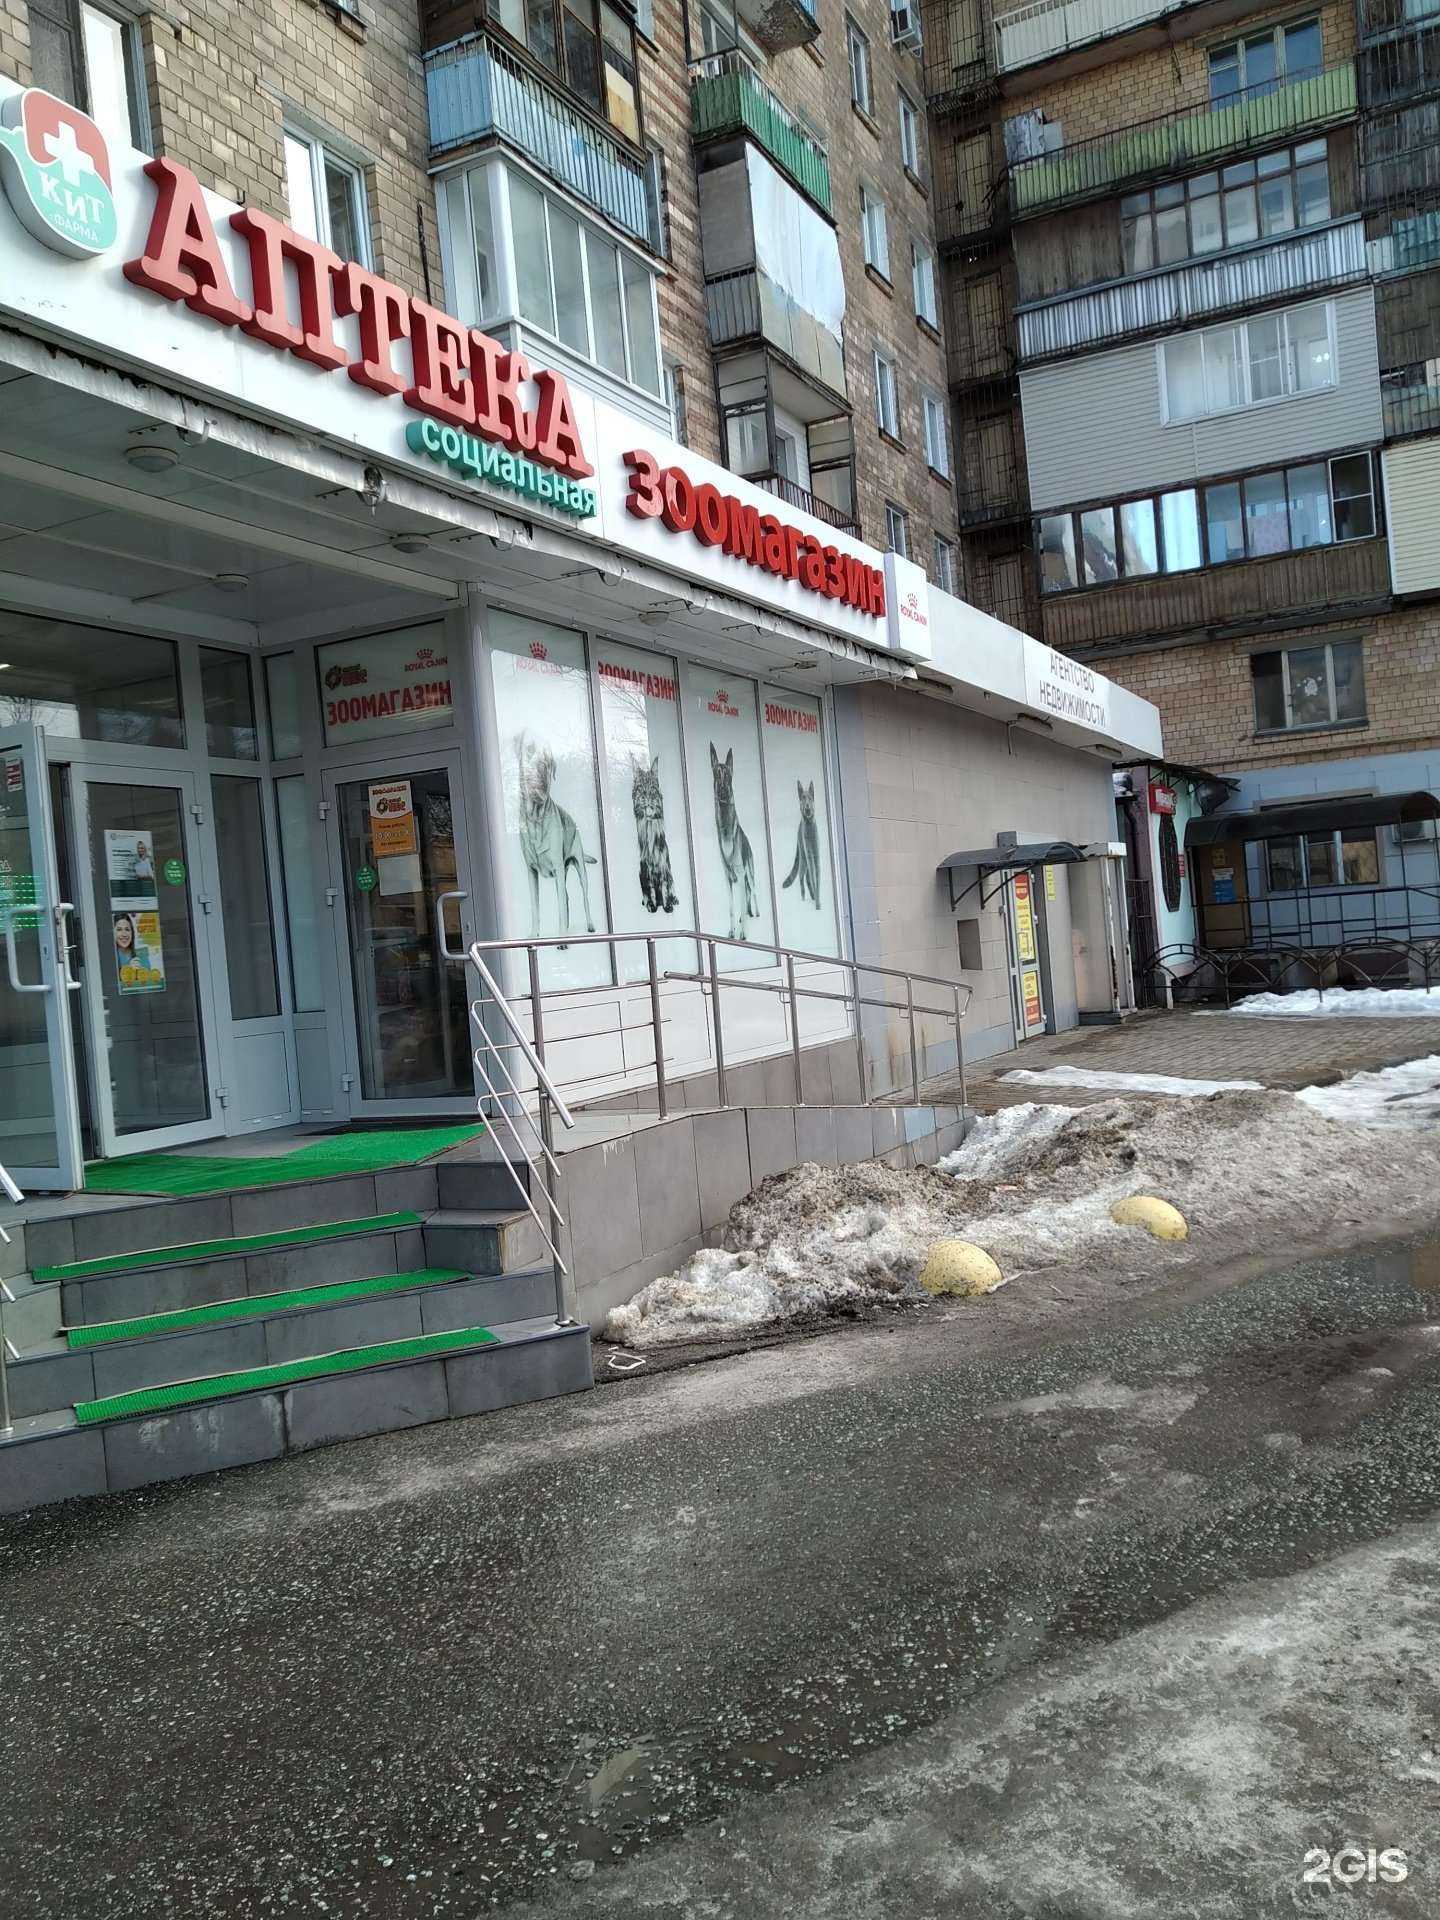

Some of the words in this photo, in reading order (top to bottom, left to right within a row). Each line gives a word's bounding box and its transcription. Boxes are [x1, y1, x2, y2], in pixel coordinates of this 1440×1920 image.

[123, 156, 595, 480] АПТЕКА
[407, 417, 597, 519] социальная
[1049, 653, 1095, 694] АГЕНТСТВО
[326, 679, 453, 726] ЗООМАГАЗИН
[764, 703, 818, 733] ЗООМАГАЗИН
[1039, 679, 1106, 728] НЕДВИЖИМОСТИ
